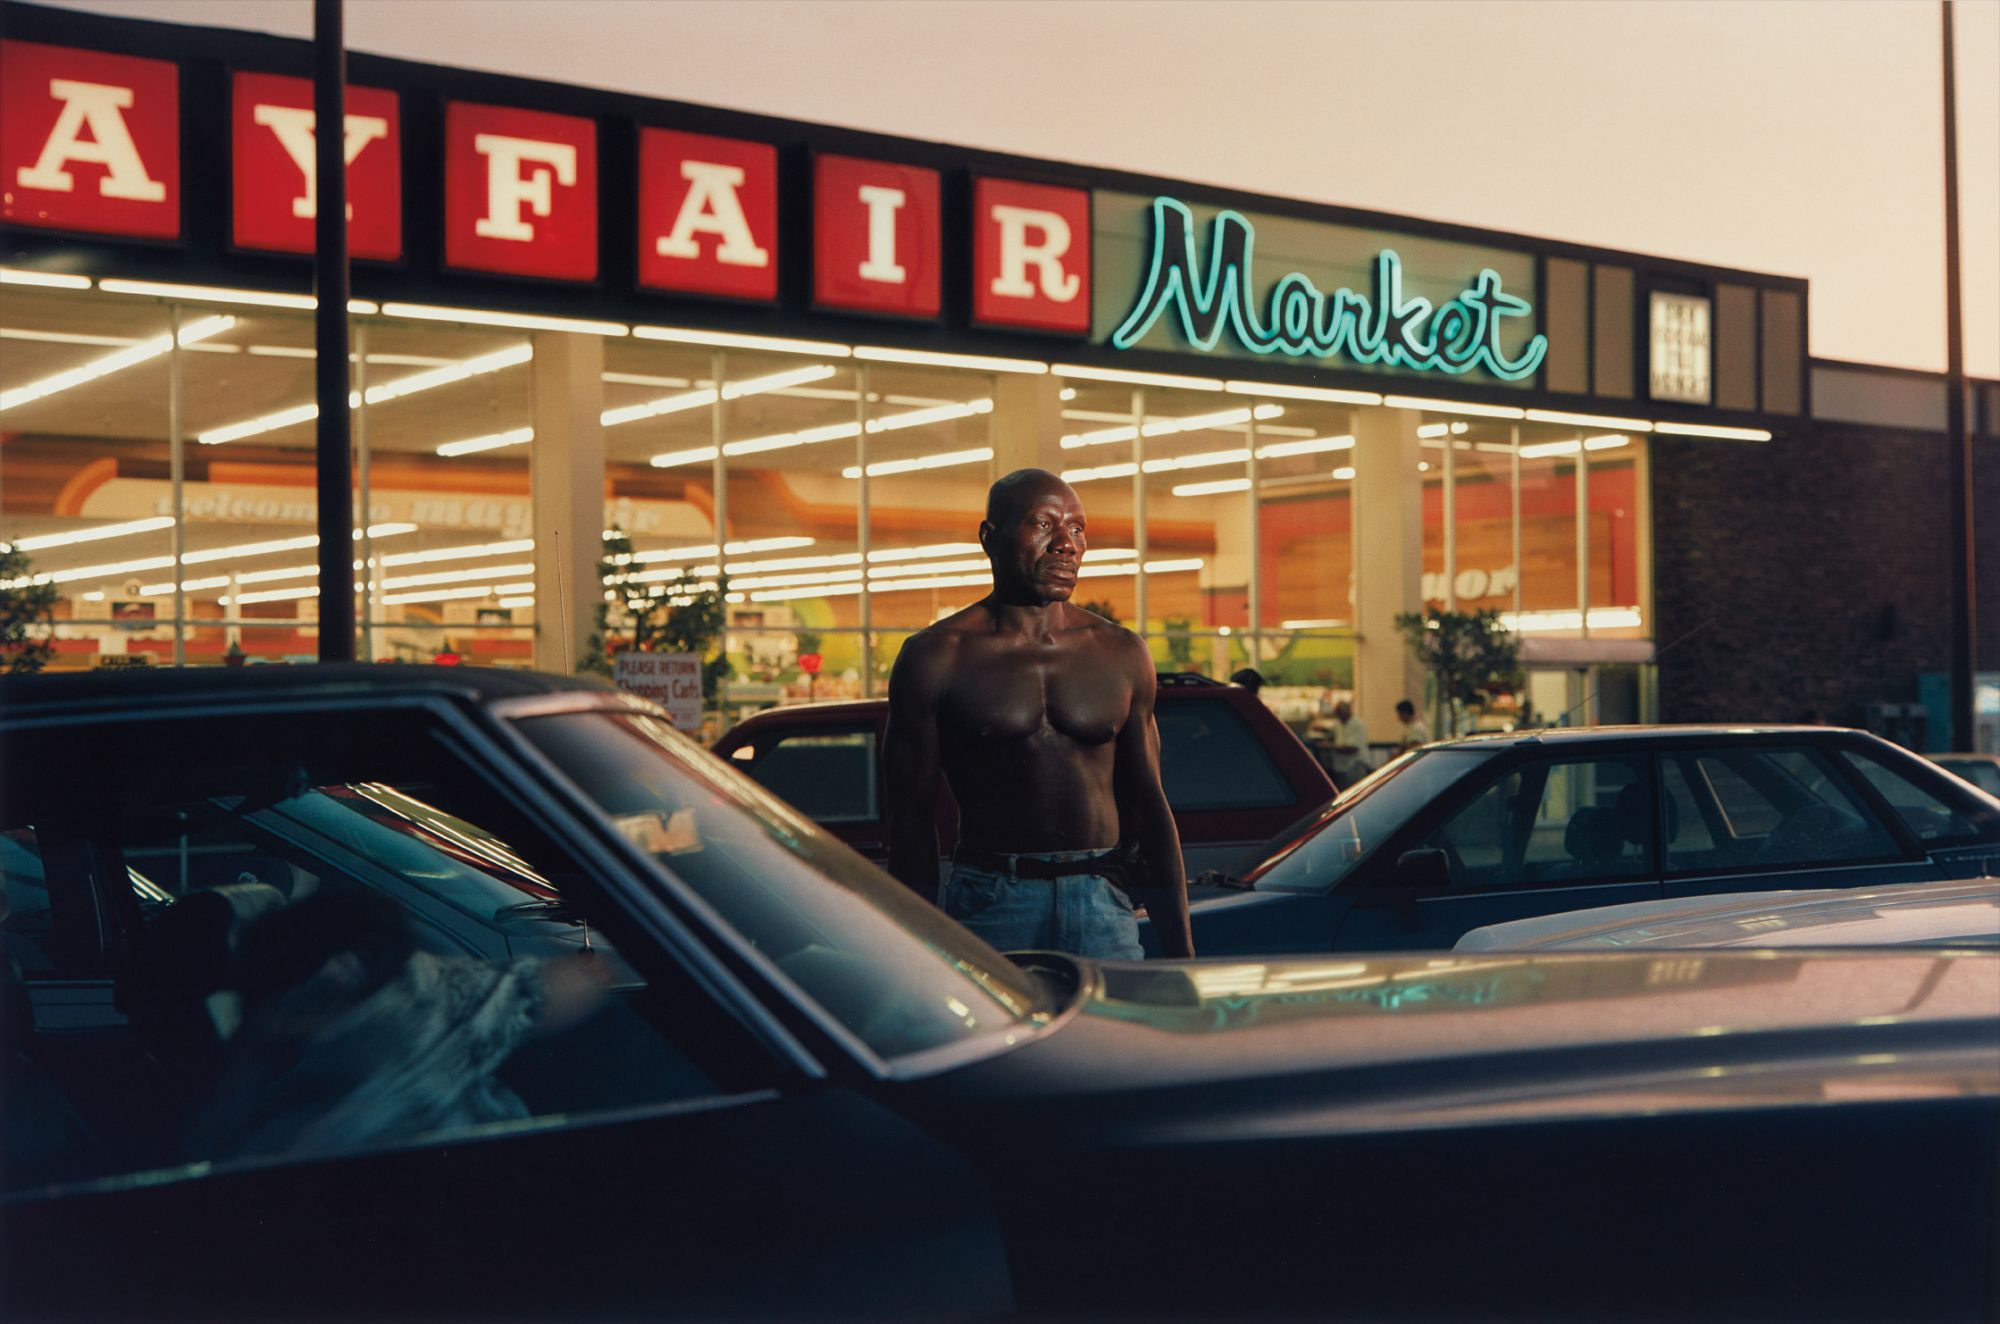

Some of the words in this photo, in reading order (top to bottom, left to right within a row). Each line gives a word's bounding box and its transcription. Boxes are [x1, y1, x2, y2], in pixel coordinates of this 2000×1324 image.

[1112, 196, 1548, 381] Market
[619, 660, 655, 675] PLEASE
[659, 660, 697, 676] RETURN
[671, 679, 700, 699] Carts
